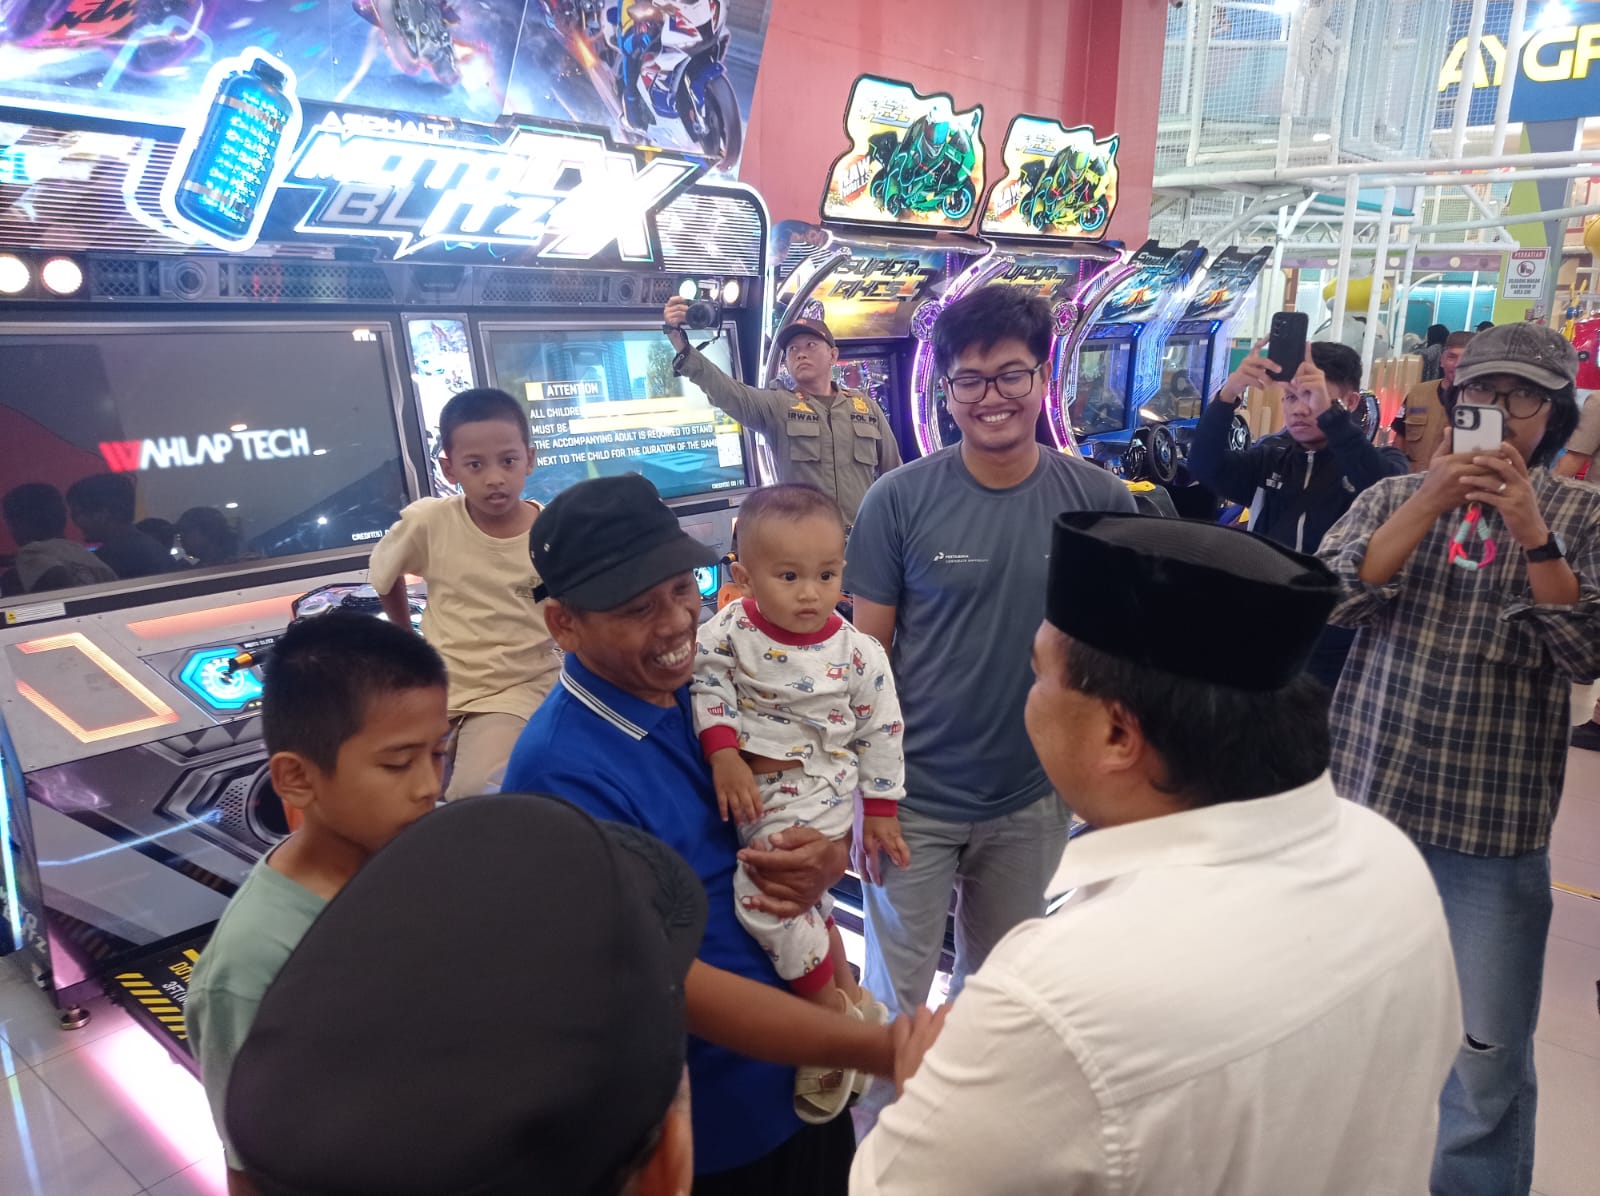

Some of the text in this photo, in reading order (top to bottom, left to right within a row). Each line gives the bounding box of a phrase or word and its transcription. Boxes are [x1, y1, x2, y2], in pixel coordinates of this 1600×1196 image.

[319, 111, 446, 141] ASPHALT
[320, 182, 549, 241] BLITZ
[834, 257, 920, 280] SUPER
[1001, 264, 1058, 282] UPER
[546, 383, 599, 397] ATTENTION
[530, 404, 587, 419] ALL CHILDRE
[787, 412, 819, 422] IRWAN
[850, 413, 866, 422] POL
[532, 422, 568, 435] MUST BE
[534, 424, 714, 450] THE ACCOMPANYING ADULT IS REQUIRED TO STAND
[98, 427, 310, 473] WAHLAP TECH
[537, 455, 558, 467] NEXT
[559, 454, 570, 465] TO
[571, 452, 587, 463] THE
[587, 449, 610, 461] CHILD
[611, 447, 626, 459] FOR
[626, 447, 641, 457] THE
[642, 442, 676, 455] DURATION
[677, 441, 687, 451] OF
[687, 440, 700, 450] THE
